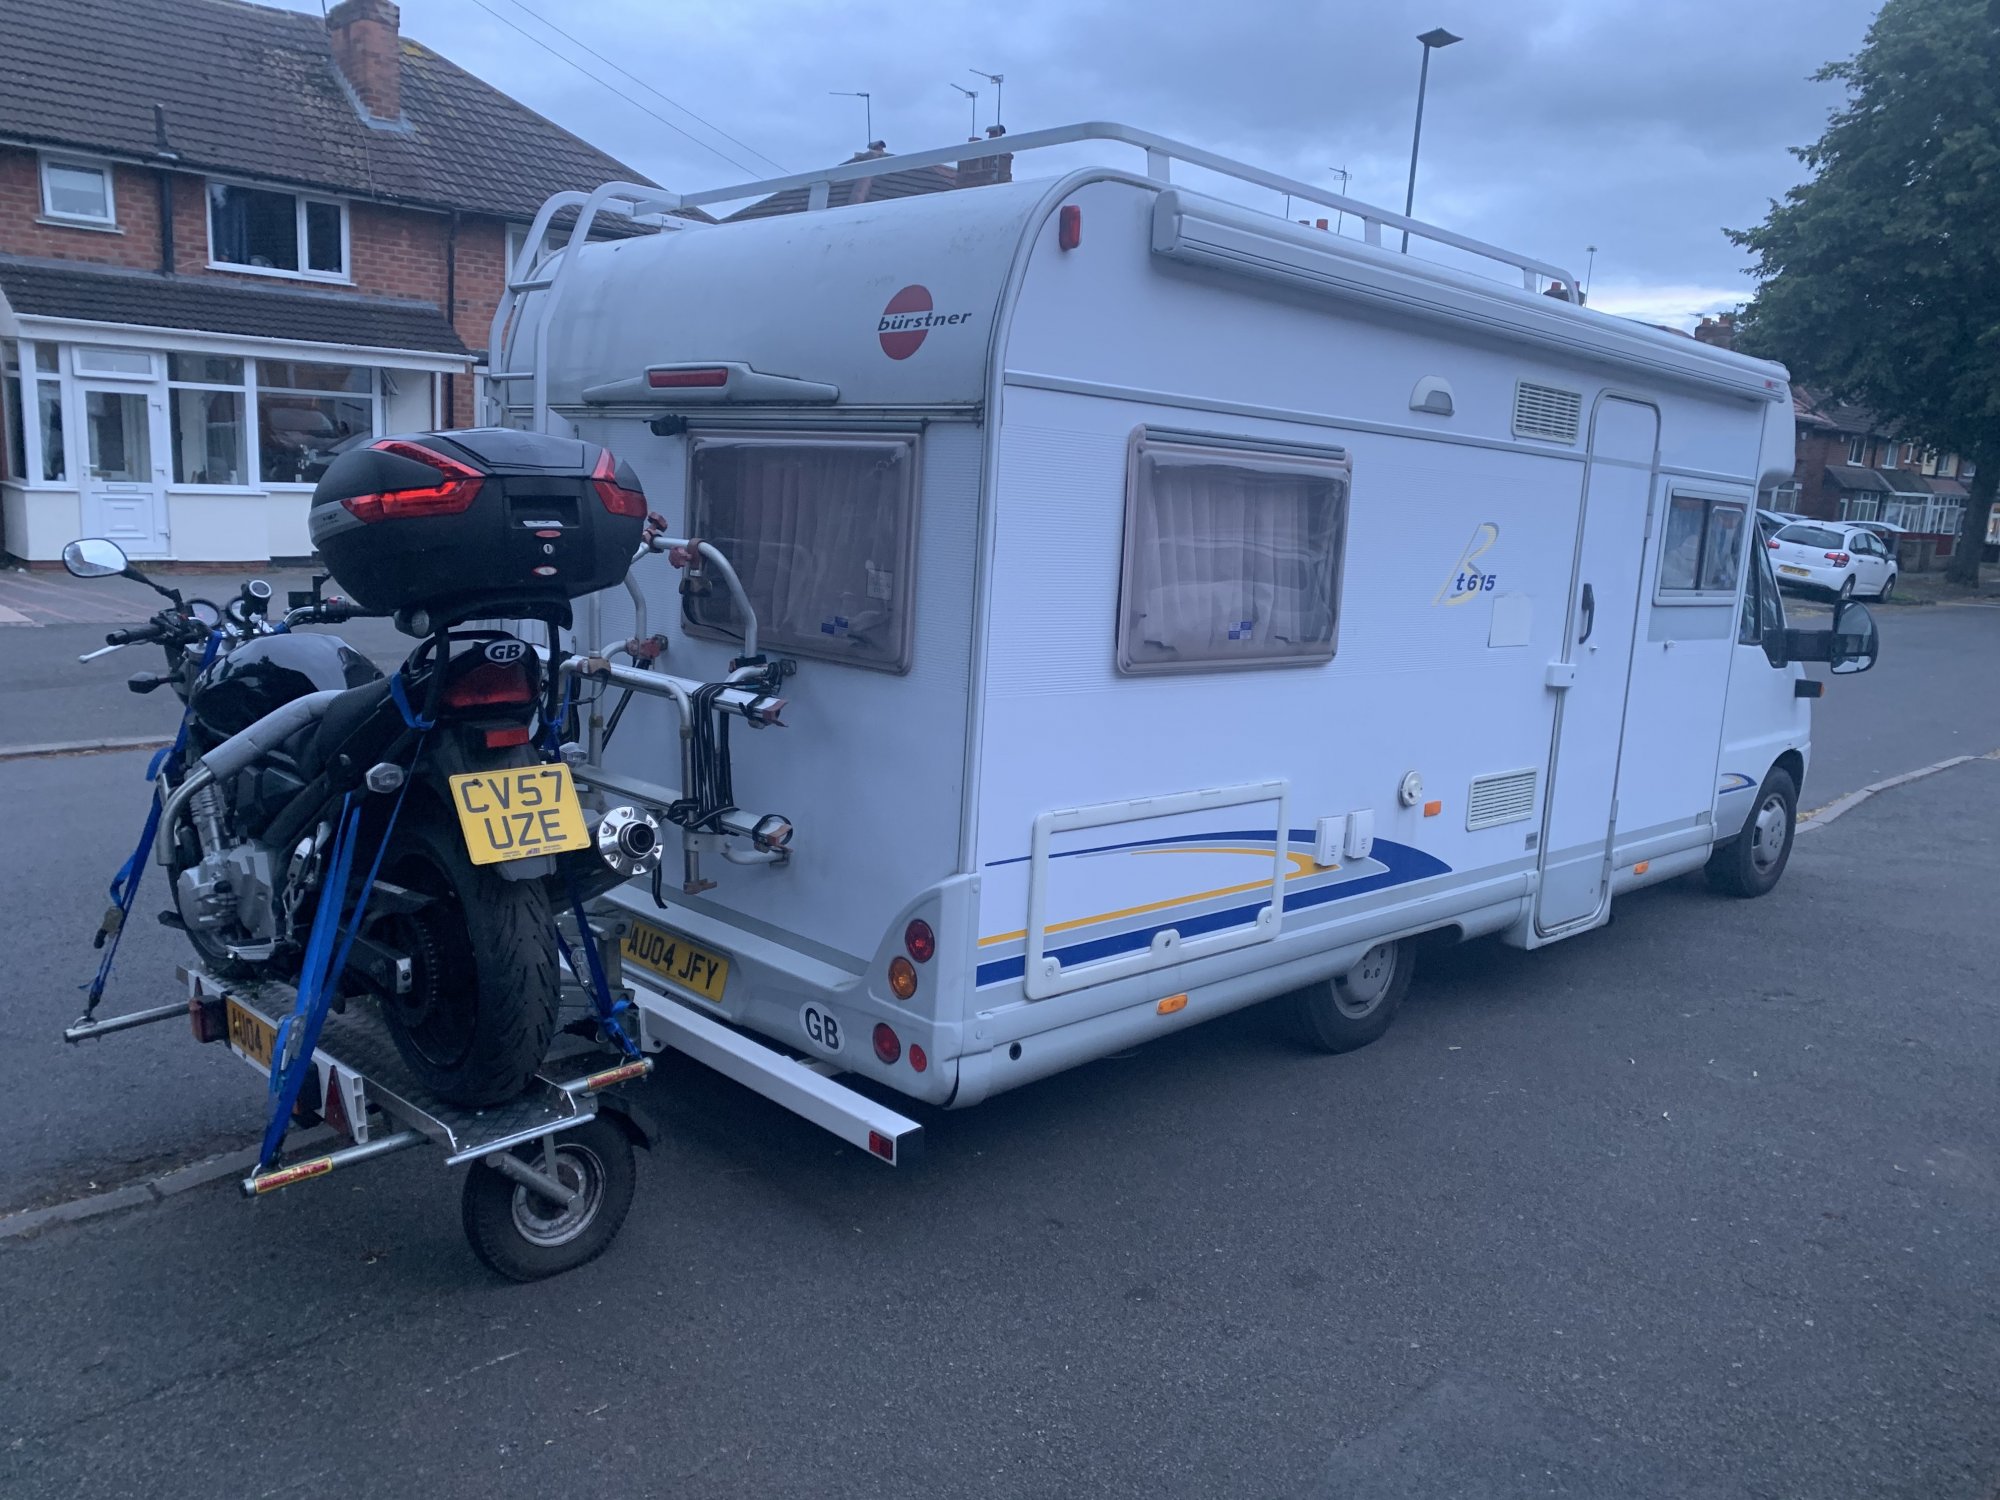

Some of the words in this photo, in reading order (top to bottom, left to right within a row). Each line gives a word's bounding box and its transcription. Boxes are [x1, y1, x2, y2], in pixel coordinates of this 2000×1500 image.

[878, 312, 972, 331] bürstner
[490, 644, 521, 660] GB
[460, 770, 563, 814] CV57
[483, 808, 568, 850] UZE
[627, 926, 676, 972] AU04
[677, 951, 719, 990] JFY
[805, 1007, 840, 1050] GB
